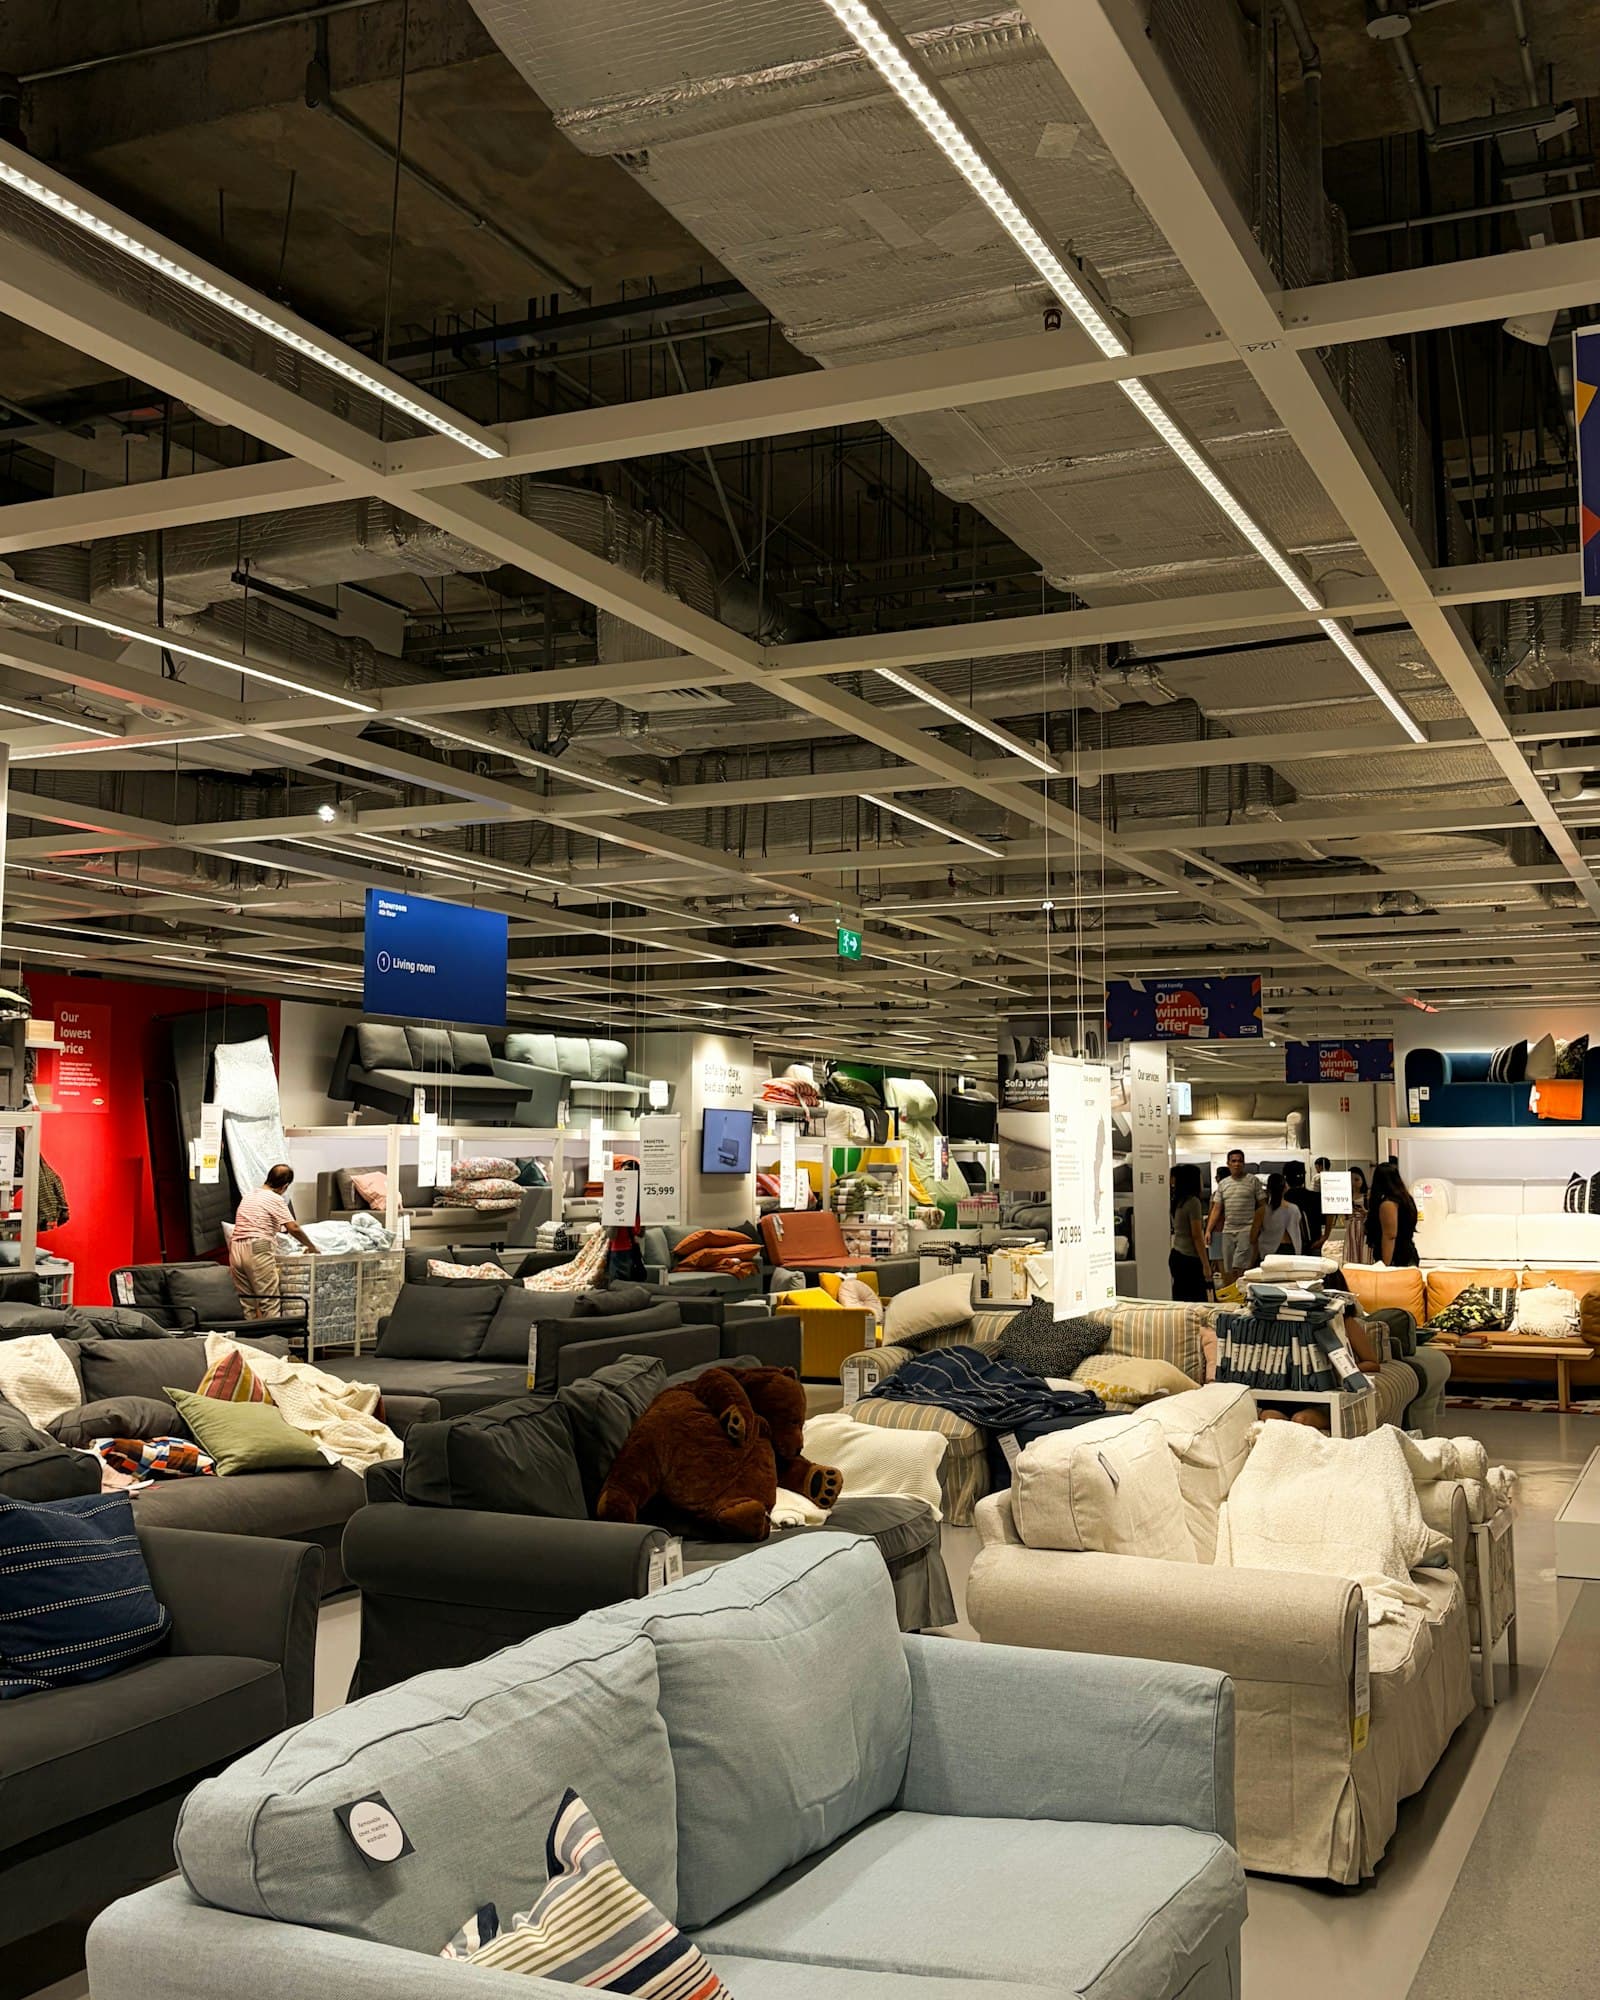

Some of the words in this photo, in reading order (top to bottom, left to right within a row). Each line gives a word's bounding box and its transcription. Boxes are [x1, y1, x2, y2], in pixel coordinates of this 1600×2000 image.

[378, 900, 407, 912] Showroom
[392, 957, 416, 973] Living
[416, 962, 436, 974] room
[1155, 992, 1181, 1004] Our
[60, 1011, 79, 1023] Our
[1155, 1004, 1209, 1020] winning
[1155, 1019, 1188, 1031] offer
[60, 1026, 91, 1039] lowest
[60, 1043, 84, 1056] price
[1320, 1049, 1338, 1059] Our
[1320, 1059, 1359, 1070] winning
[1137, 1069, 1145, 1080] Our
[1145, 1072, 1160, 1082] services
[1320, 1068, 1344, 1078] offer
[1005, 1079, 1024, 1088] Sofa
[1025, 1078, 1036, 1089] by
[1037, 1078, 1048, 1087] da
